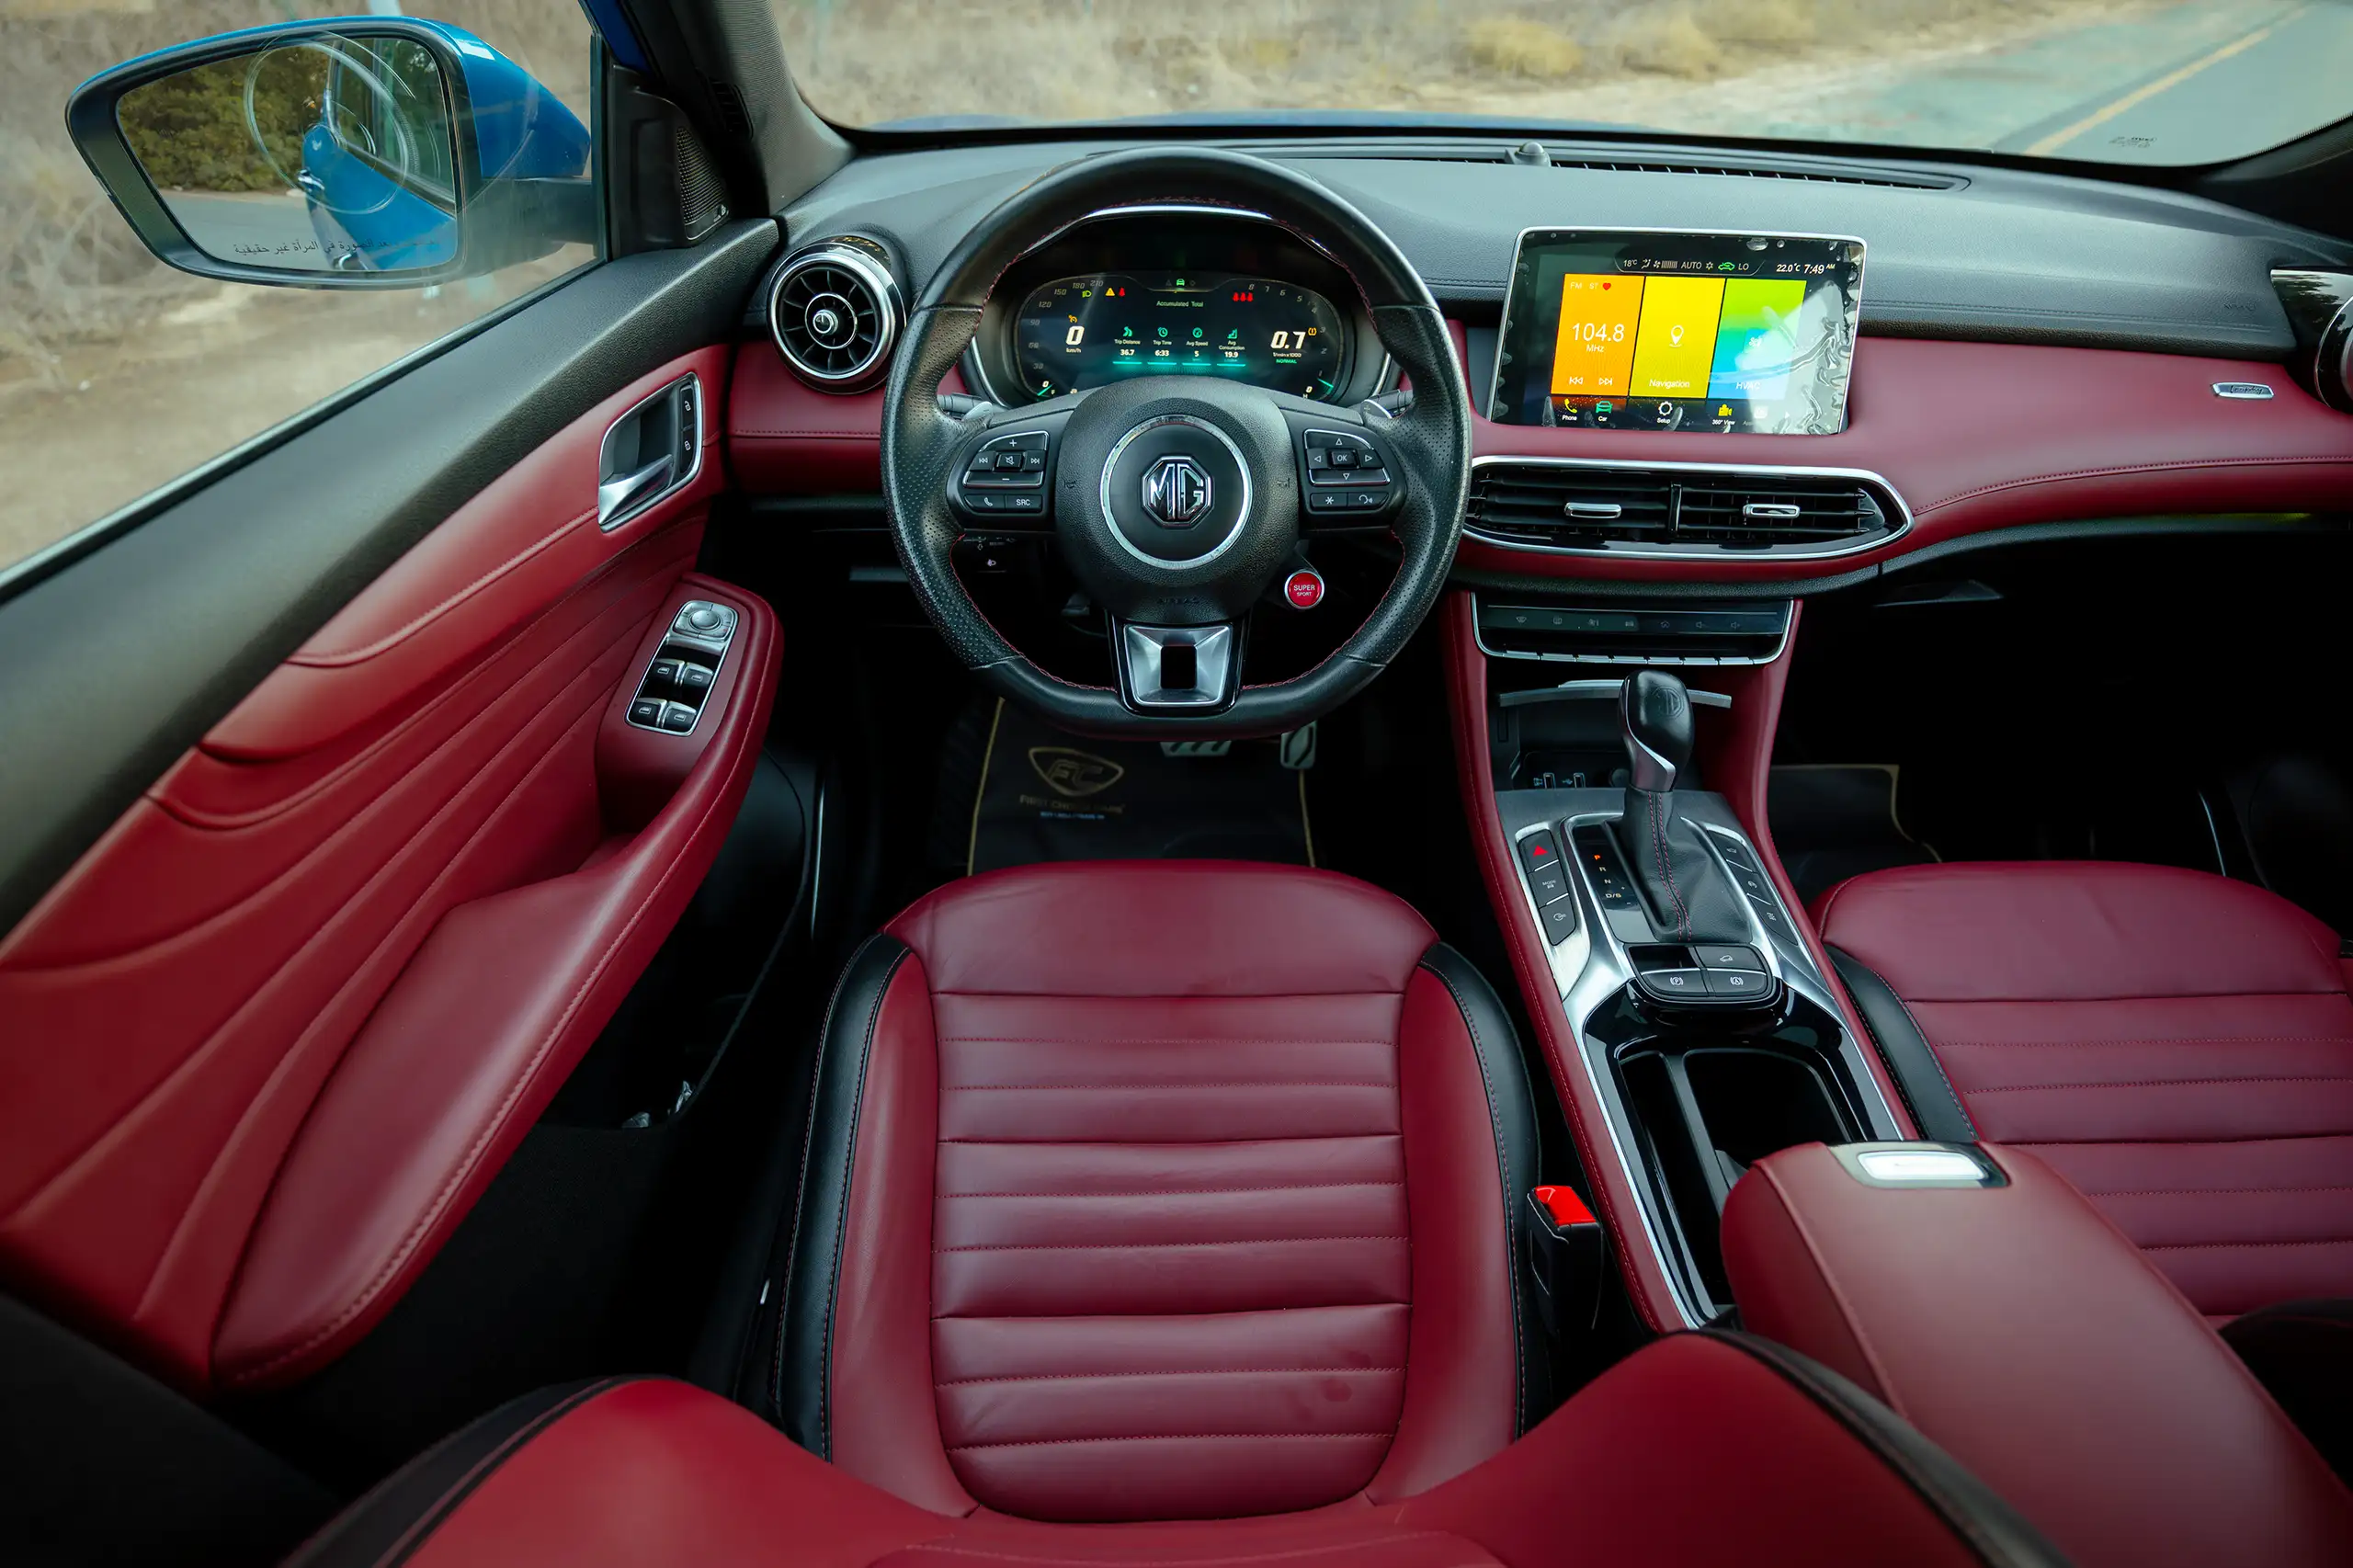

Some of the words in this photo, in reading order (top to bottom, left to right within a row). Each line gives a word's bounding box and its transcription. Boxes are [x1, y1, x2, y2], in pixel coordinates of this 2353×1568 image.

[274, 242, 290, 255] غير
[1681, 261, 1702, 270] AUTO
[1738, 263, 1749, 271] LO
[1803, 264, 1824, 275] 7:49
[1065, 325, 1085, 346] 0
[1572, 322, 1625, 343] 104.8
[1270, 330, 1306, 349] 0.7
[1586, 344, 1605, 353] MHz
[1649, 378, 1690, 390] Navigation
[1736, 381, 1761, 391] HVAC
